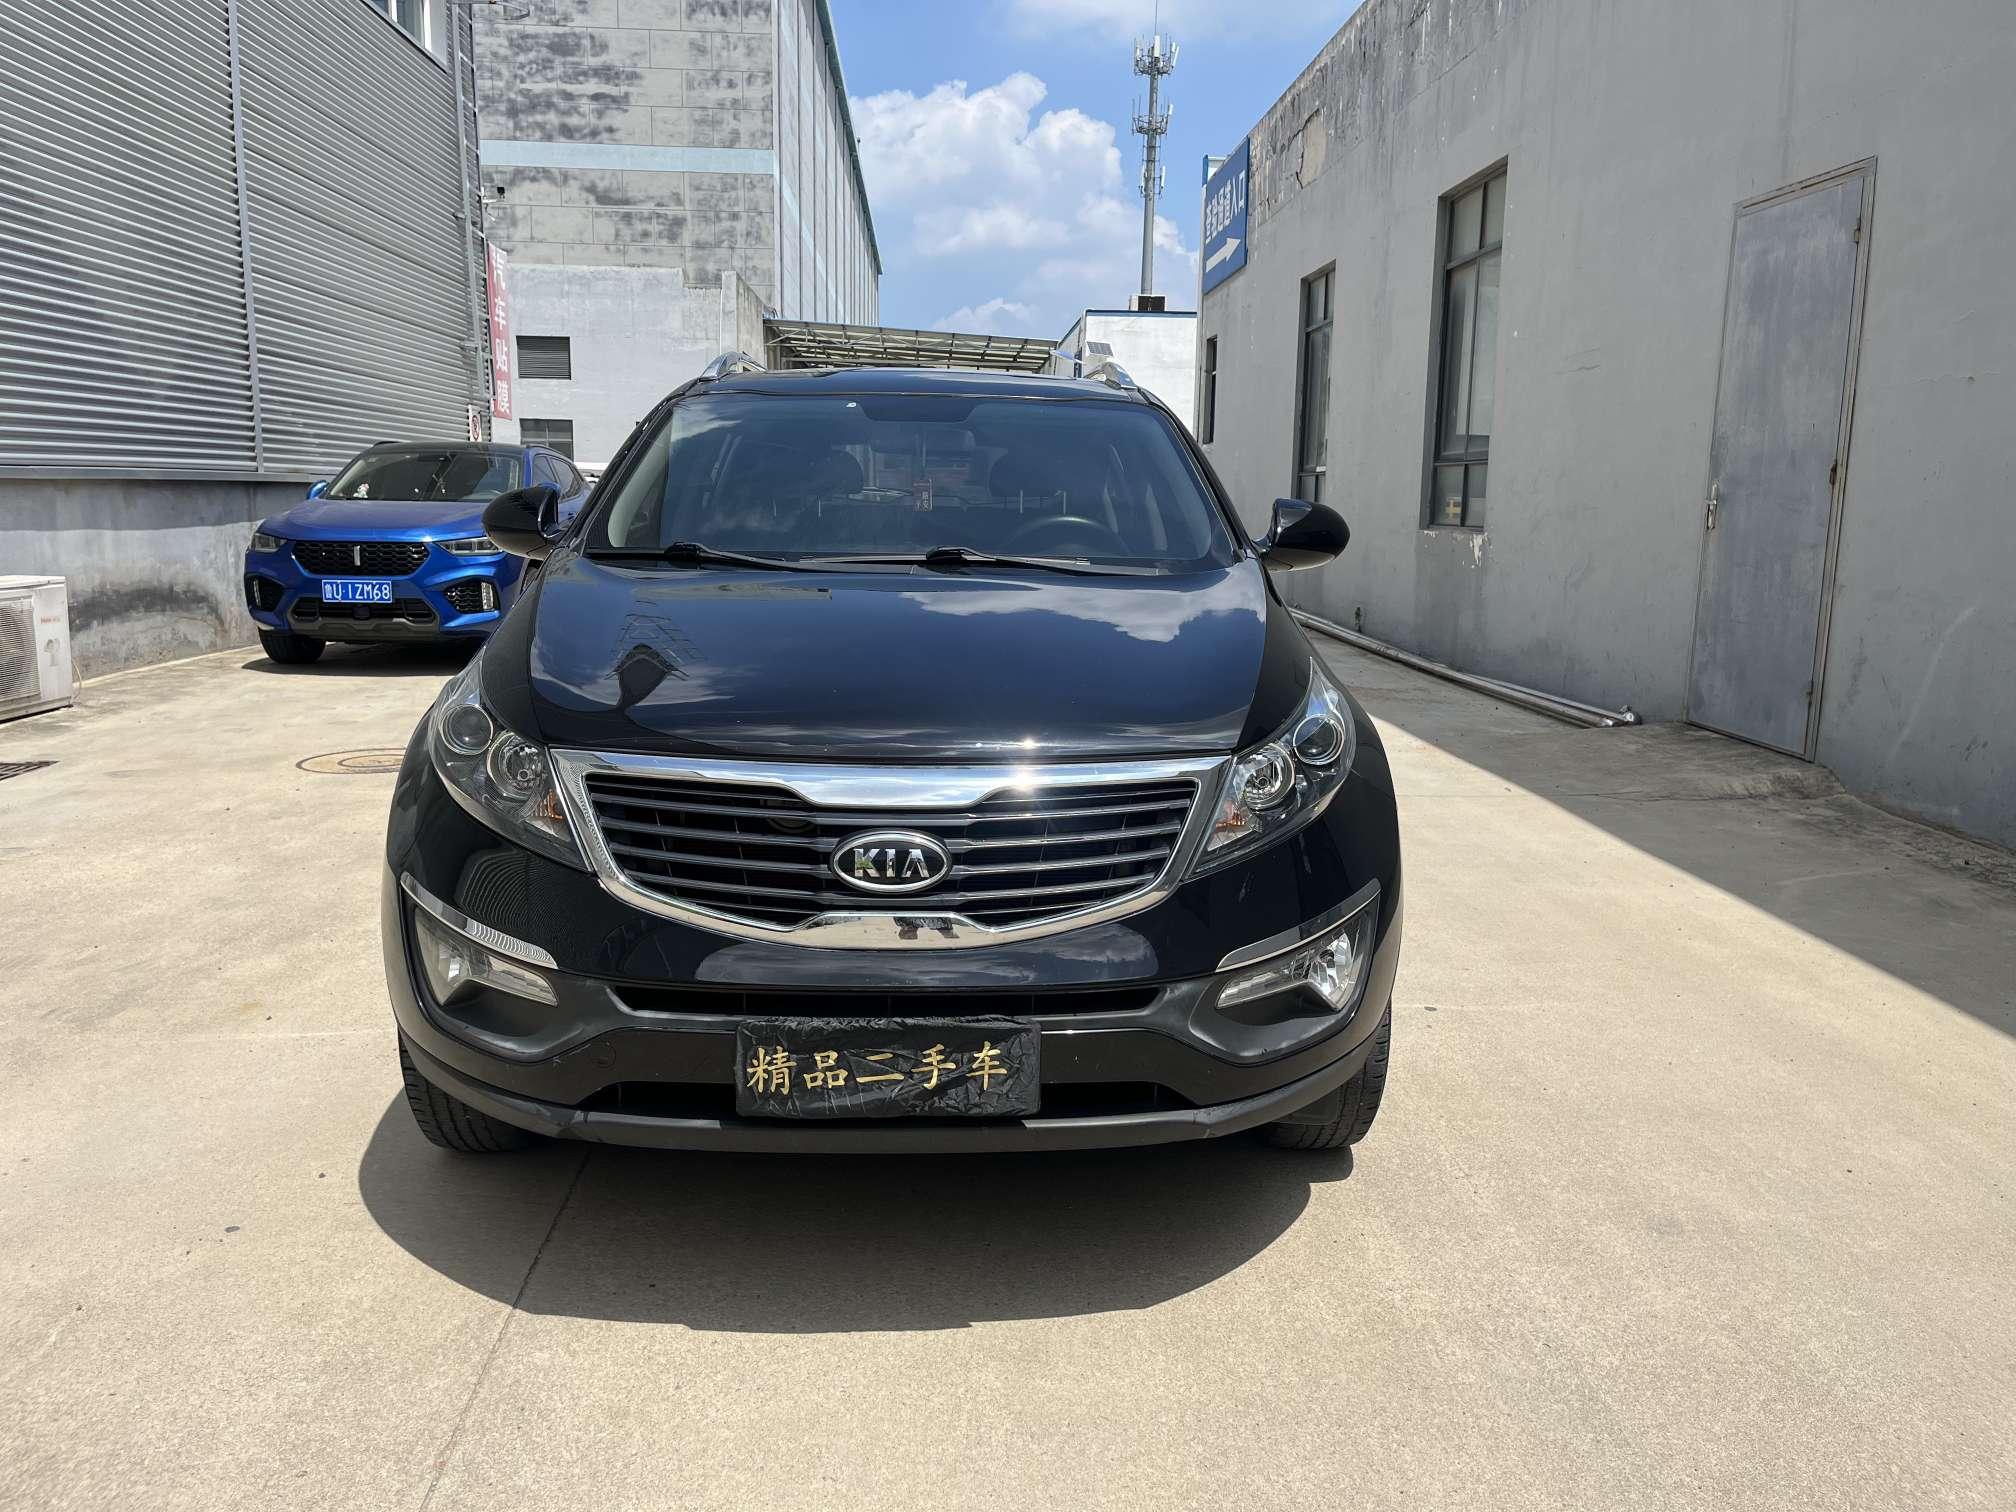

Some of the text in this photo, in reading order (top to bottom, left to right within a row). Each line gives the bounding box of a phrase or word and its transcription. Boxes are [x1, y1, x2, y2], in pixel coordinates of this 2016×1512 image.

[493, 249, 511, 413] 汽车贴膜
[853, 848, 930, 878] KIA
[747, 1040, 1007, 1096] 精品二手车
